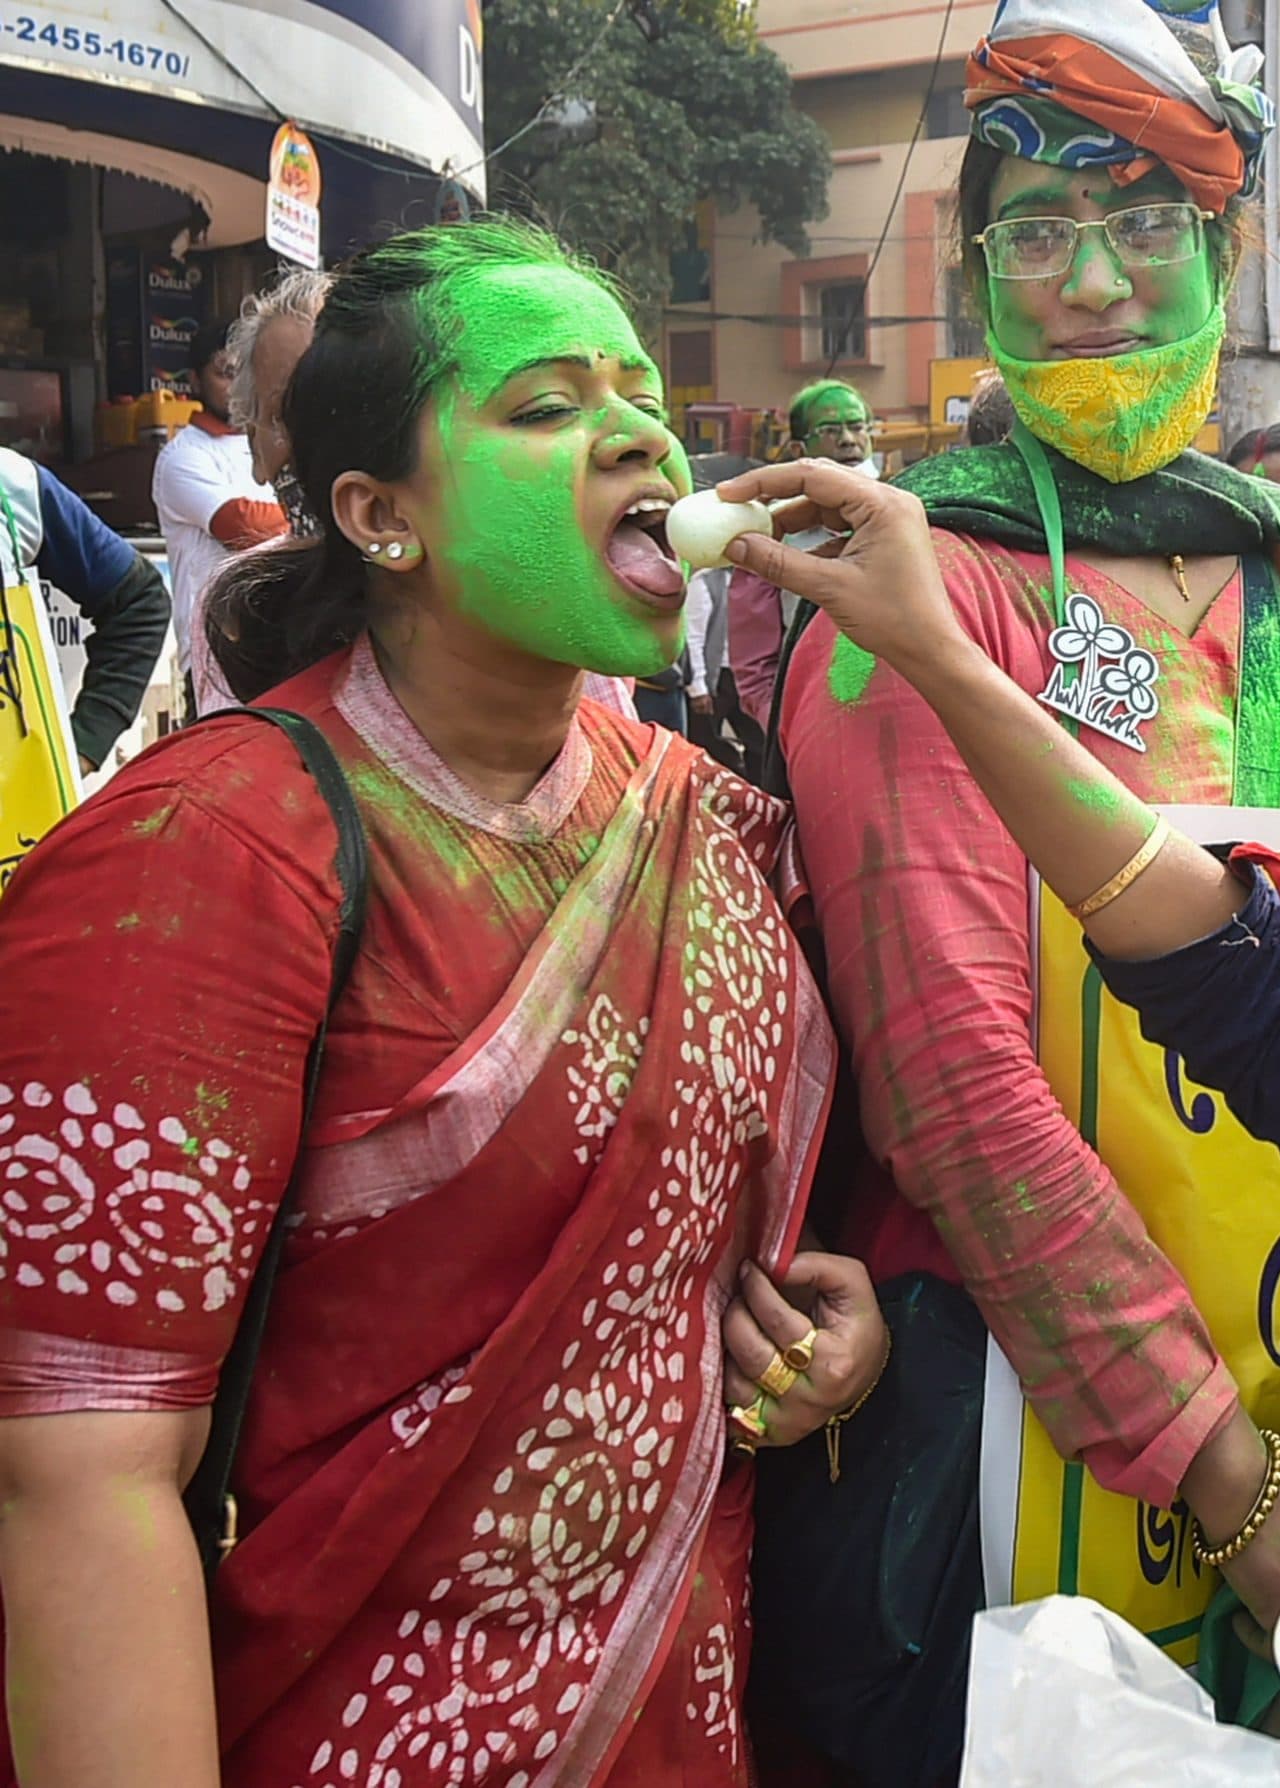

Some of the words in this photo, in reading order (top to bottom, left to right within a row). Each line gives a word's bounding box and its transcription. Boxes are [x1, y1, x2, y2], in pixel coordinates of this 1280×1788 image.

[0, 16, 190, 78] -2455-1670/
[149, 272, 192, 291] Dulux
[150, 325, 192, 342] Dulux
[151, 376, 193, 393] Dulux
